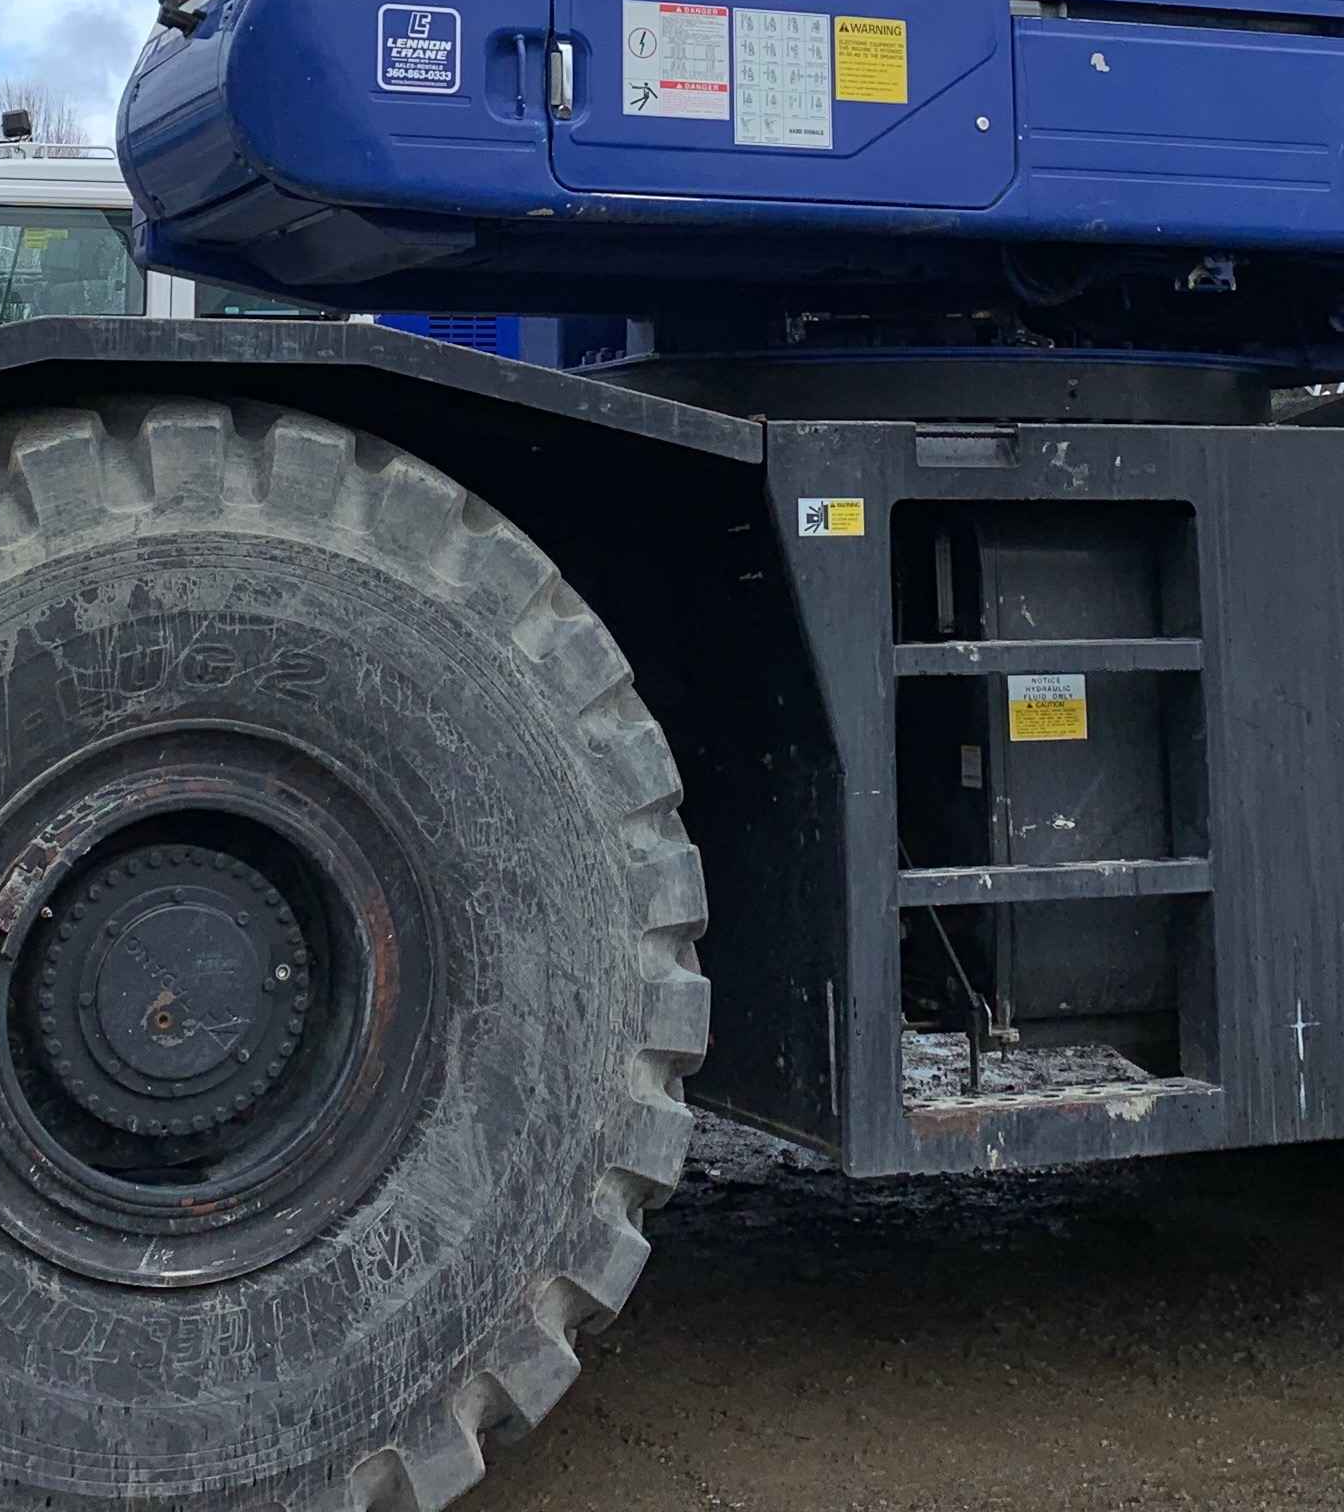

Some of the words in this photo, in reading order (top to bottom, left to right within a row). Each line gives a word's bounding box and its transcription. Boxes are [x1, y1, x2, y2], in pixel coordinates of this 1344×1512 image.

[849, 23, 903, 37] WARNING
[386, 37, 453, 51] LENNON
[390, 47, 448, 60] CRANE
[1031, 676, 1061, 685] NOTICE
[1025, 684, 1071, 693] HYDRAULIC
[1023, 693, 1047, 701] FLUID
[1052, 692, 1073, 700] ONLY
